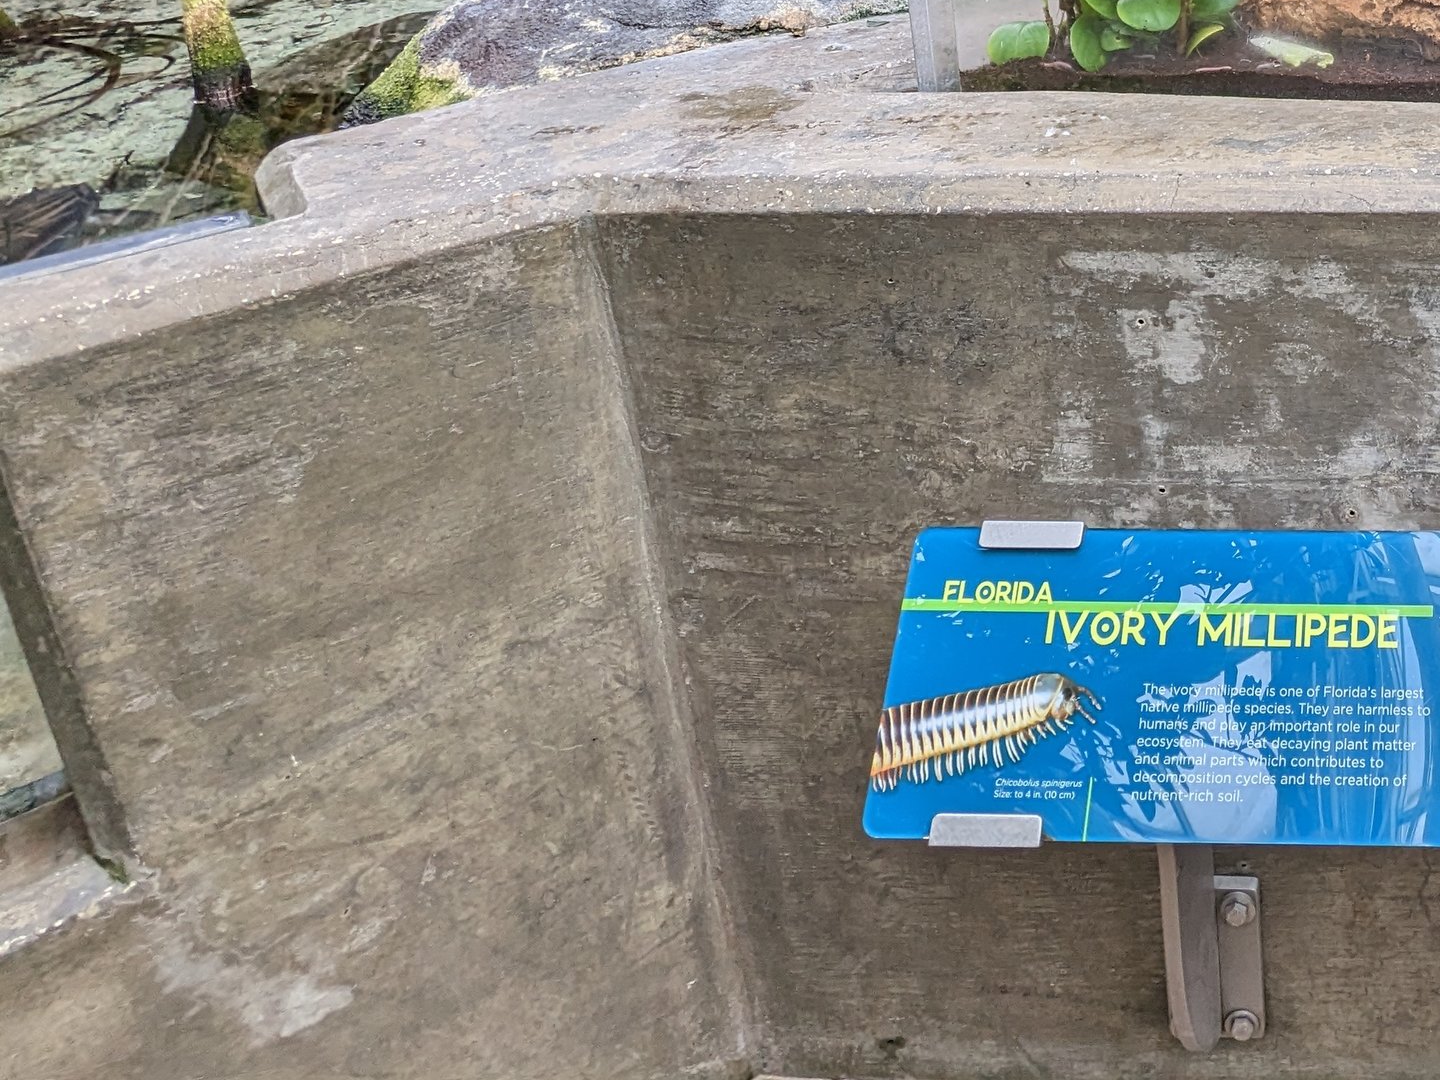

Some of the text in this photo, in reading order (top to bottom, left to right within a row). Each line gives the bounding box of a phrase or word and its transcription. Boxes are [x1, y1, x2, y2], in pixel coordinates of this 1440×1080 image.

[942, 580, 1053, 605] FLORIDA
[1044, 609, 1400, 649] IVORY MILLIPEDE
[1143, 683, 1424, 700] The ivory millipede is one of Florida’s largest
[1140, 700, 1431, 717] native millipede species. They are harmless to
[1138, 718, 1400, 733] humans and play an important role in our
[1136, 736, 1416, 751] ecosystem. They eat decaying plant matter
[1135, 753, 1384, 768] and animal parts which contributes to
[995, 778, 1083, 789] Chicobolus spinigerus
[1133, 771, 1407, 787] decomposition cycles and the creation of
[1025, 790, 1031, 799] 4
[1044, 790, 1057, 800] (10
[1059, 791, 1075, 800] cm)
[1131, 790, 1243, 802] nutrient-rich soil.
